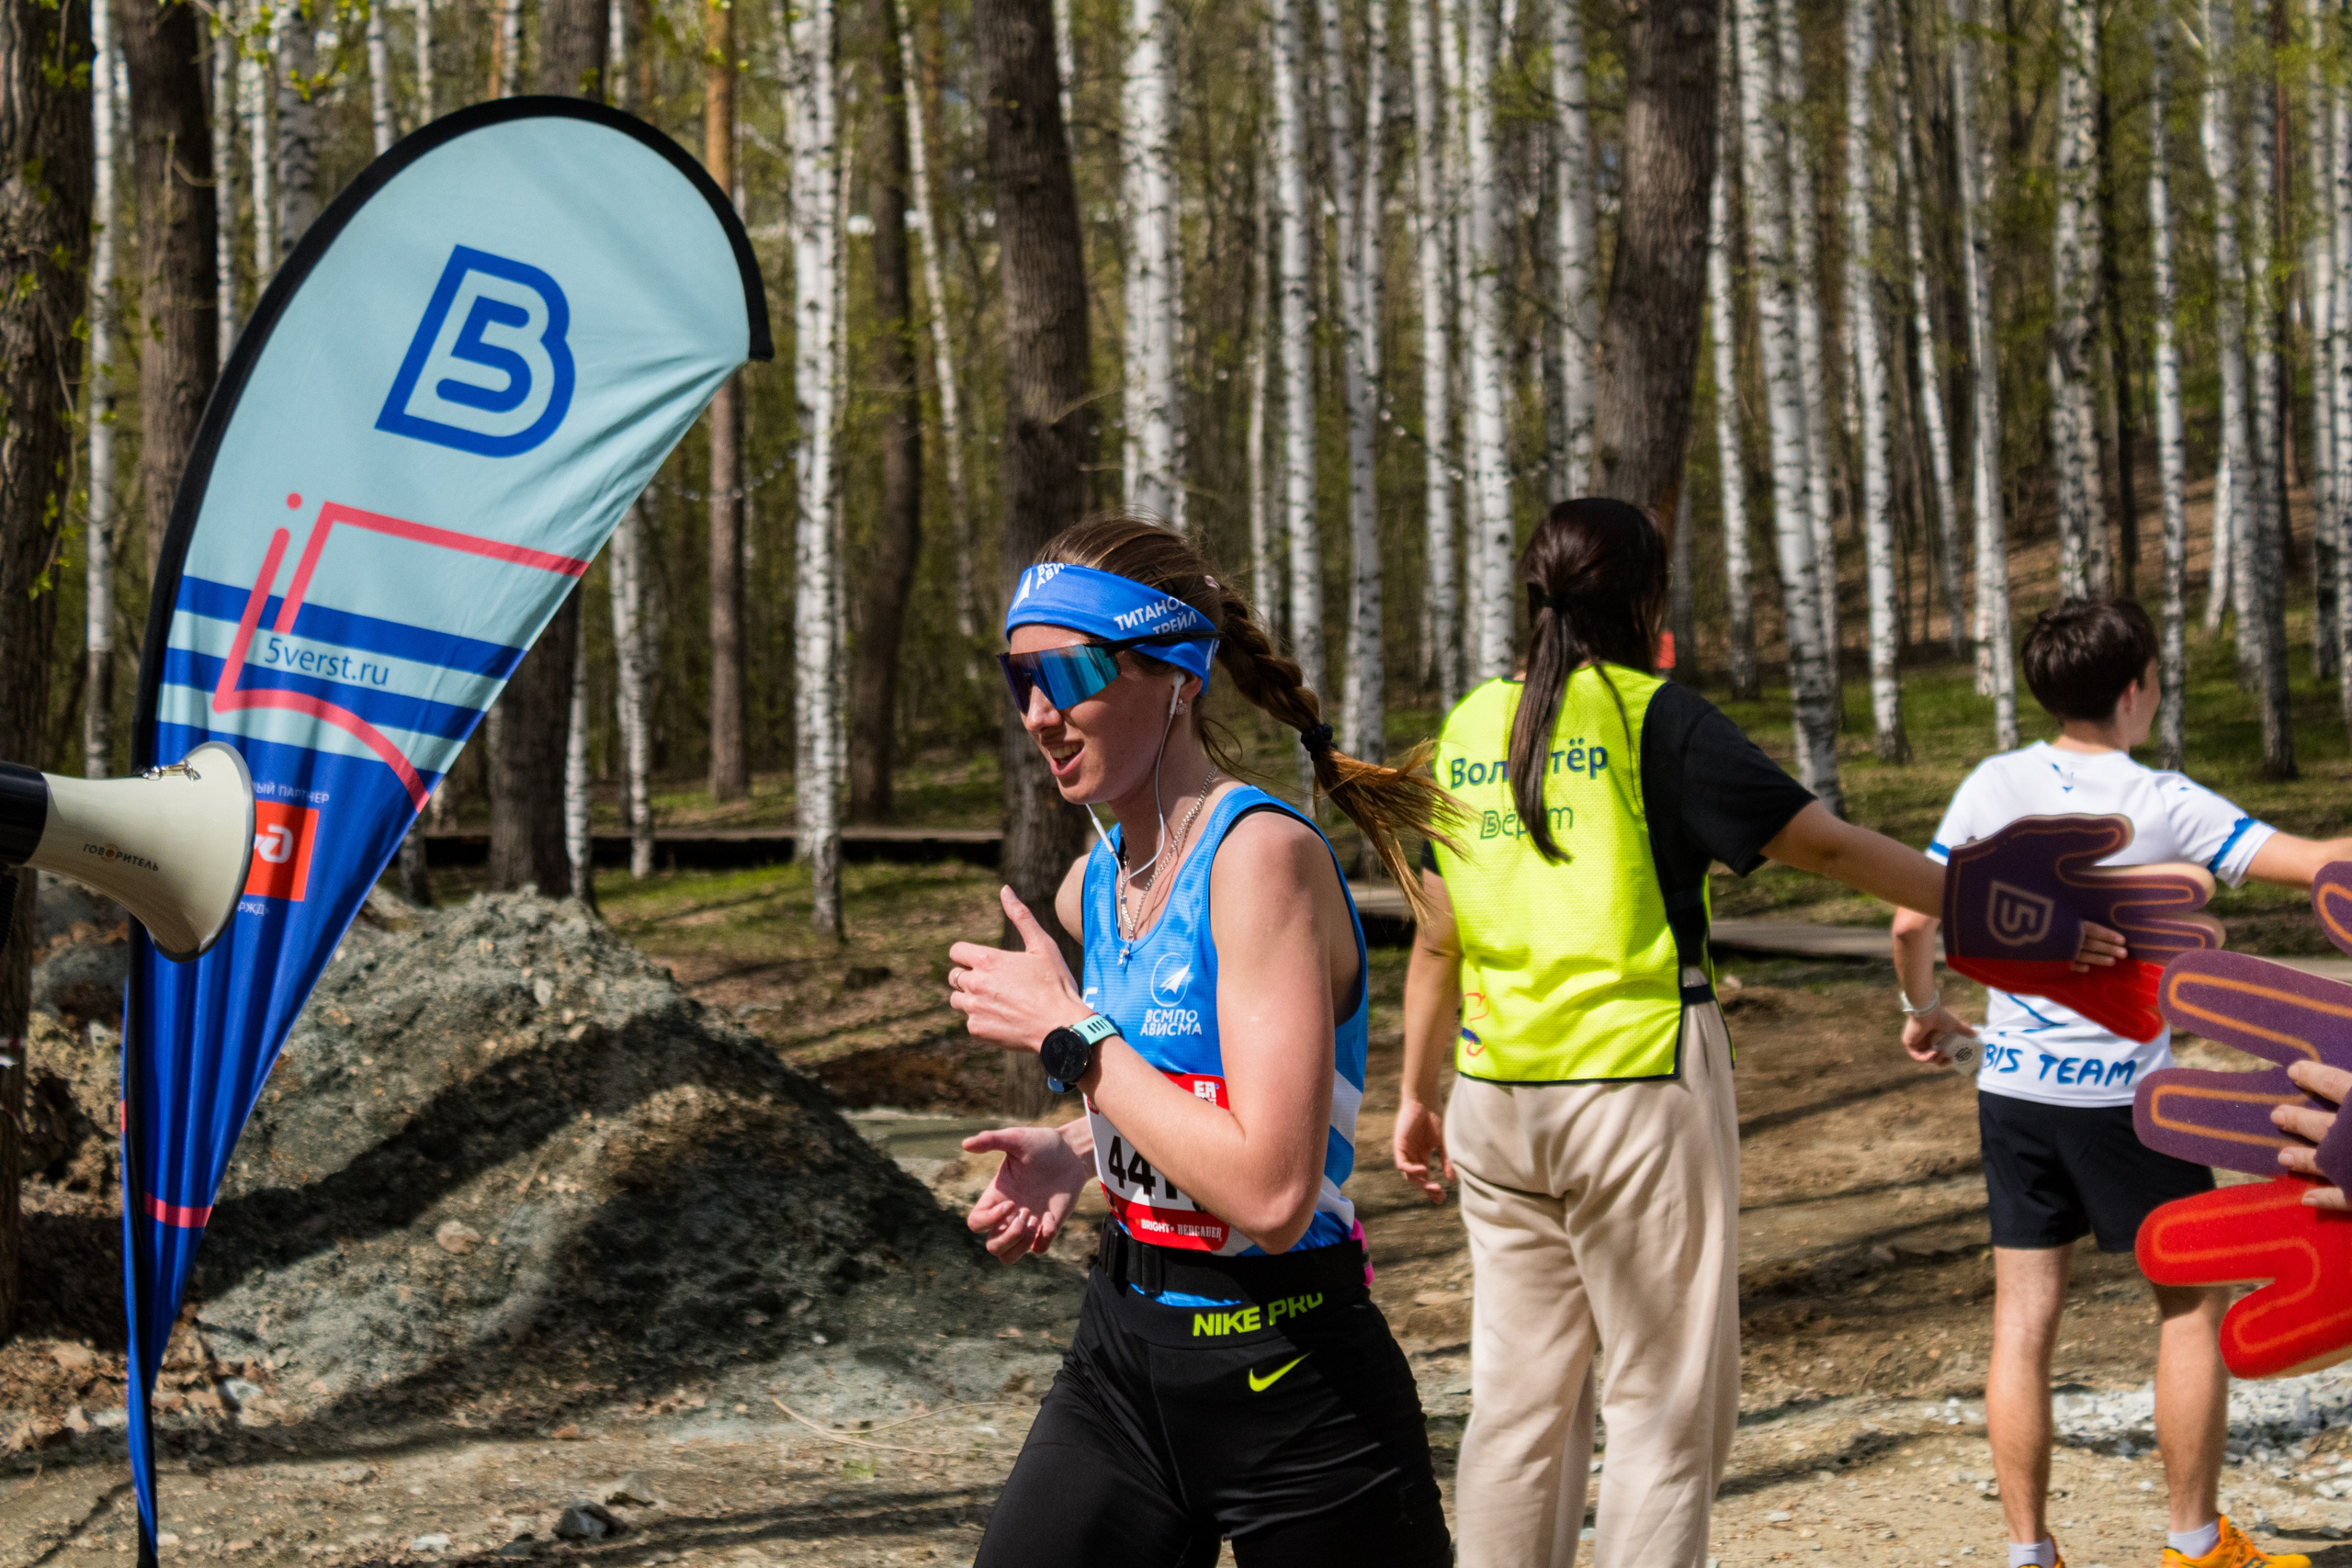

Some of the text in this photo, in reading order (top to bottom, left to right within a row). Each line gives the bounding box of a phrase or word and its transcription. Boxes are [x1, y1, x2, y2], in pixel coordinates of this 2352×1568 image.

[1152, 611, 1197, 635] ТРЕЙЛ
[265, 637, 389, 686] 5verst.ru
[1450, 737, 1609, 789] Волтёр
[253, 781, 330, 804] ЫЙ ПАРТНЕР
[1145, 1008, 1199, 1024] ВСМПО
[1139, 1022, 1203, 1037] АВИСМА
[2039, 1054, 2137, 1088] TEAM
[1140, 1218, 1170, 1234] BRIGHT
[1177, 1224, 1223, 1239] BERGAUER
[1193, 1305, 1261, 1337] NIKE
